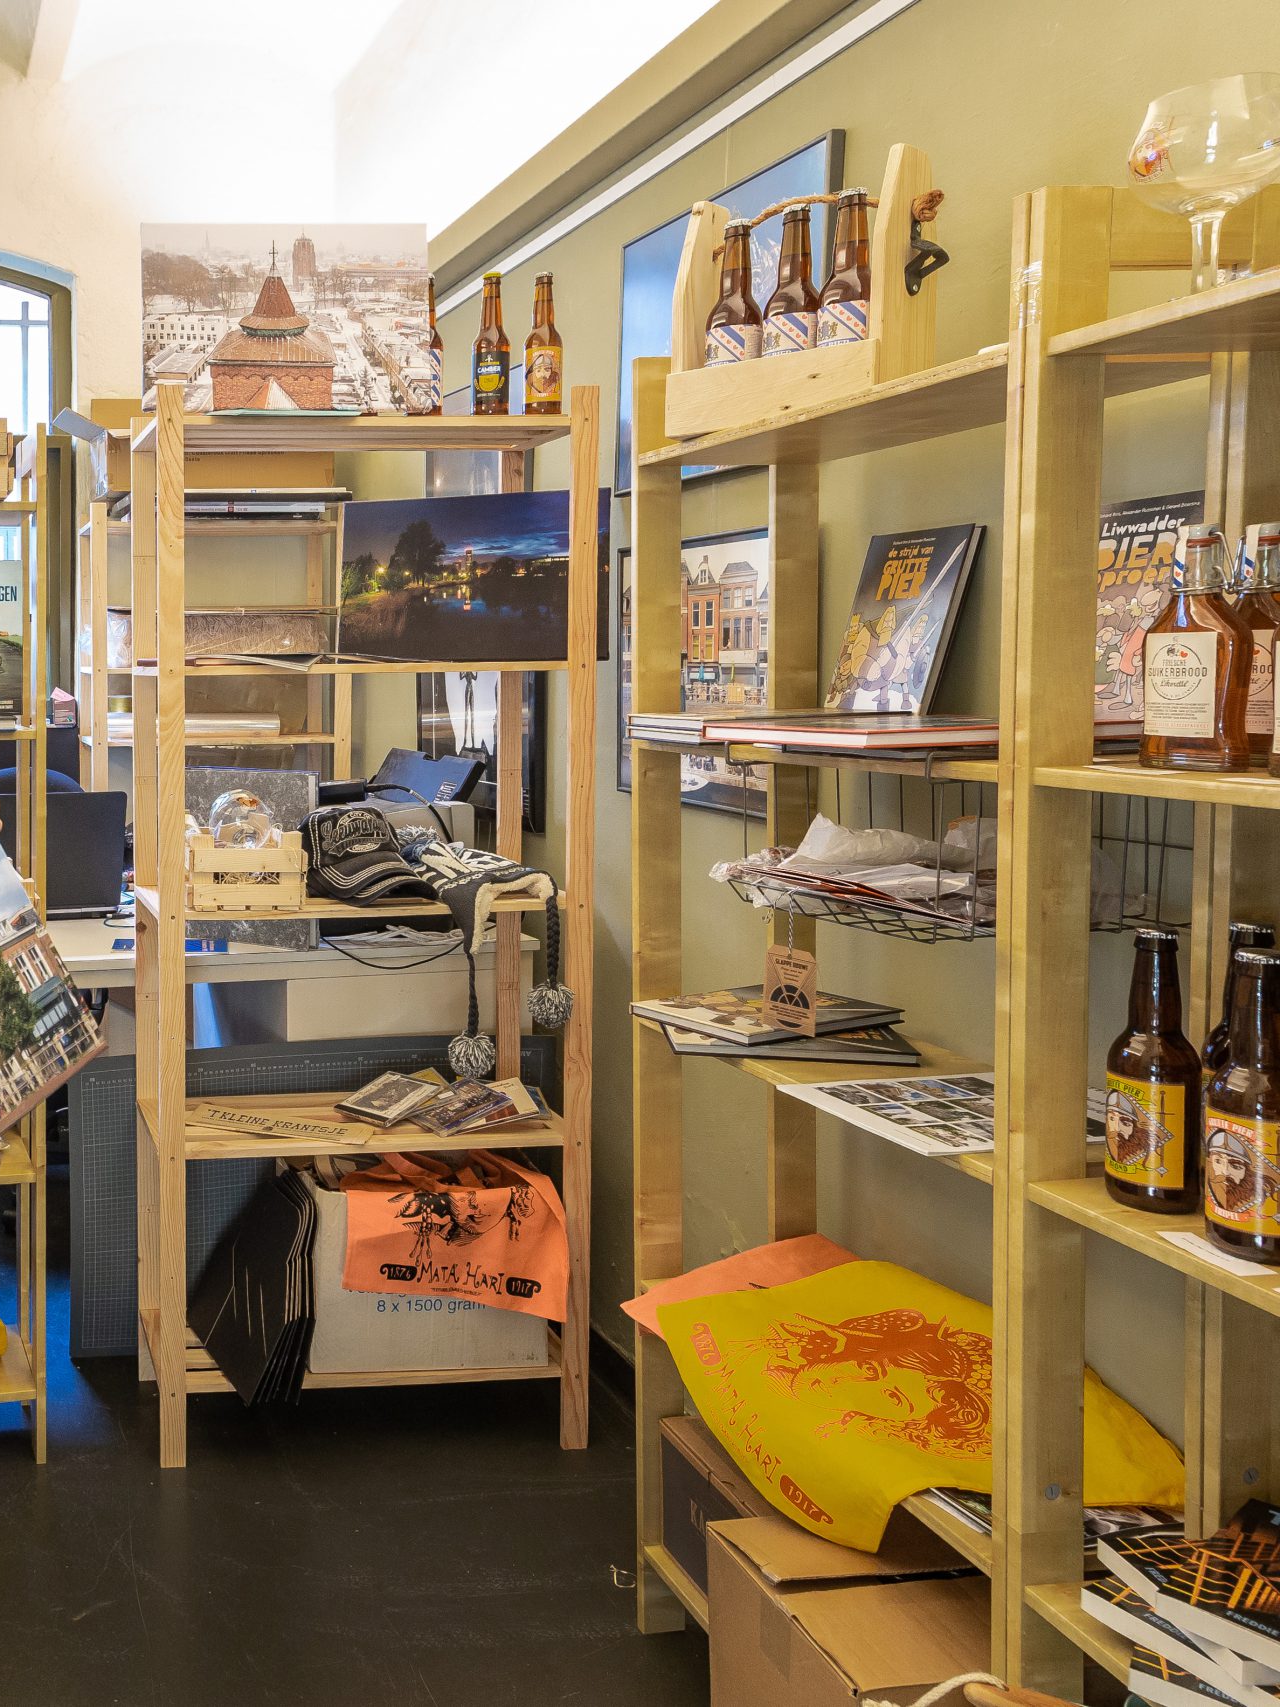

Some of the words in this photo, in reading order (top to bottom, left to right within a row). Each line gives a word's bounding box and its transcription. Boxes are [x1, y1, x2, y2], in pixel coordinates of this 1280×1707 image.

[1101, 514, 1186, 538] Liwwadder
[888, 549, 897, 558] de
[899, 546, 919, 560] strijd
[921, 546, 934, 554] van
[883, 556, 931, 575] GRUTTE
[875, 572, 927, 601] PIER
[1098, 566, 1172, 593] proer
[1148, 667, 1208, 677] SUIKERBROOD
[1123, 1084, 1141, 1098] PIER
[220, 1111, 270, 1126] KLEINE
[272, 1119, 348, 1135] KRANTSJE
[417, 1260, 460, 1283] MATA
[463, 1262, 505, 1295] HARI
[511, 1281, 532, 1294] 1917
[377, 1299, 386, 1313] 8
[391, 1302, 400, 1313] x
[406, 1299, 442, 1312] 1500
[448, 1301, 486, 1314] gram
[737, 1413, 782, 1484] HARI
[788, 1484, 820, 1516] 1917
[1225, 1610, 1280, 1637] FREDDIE
